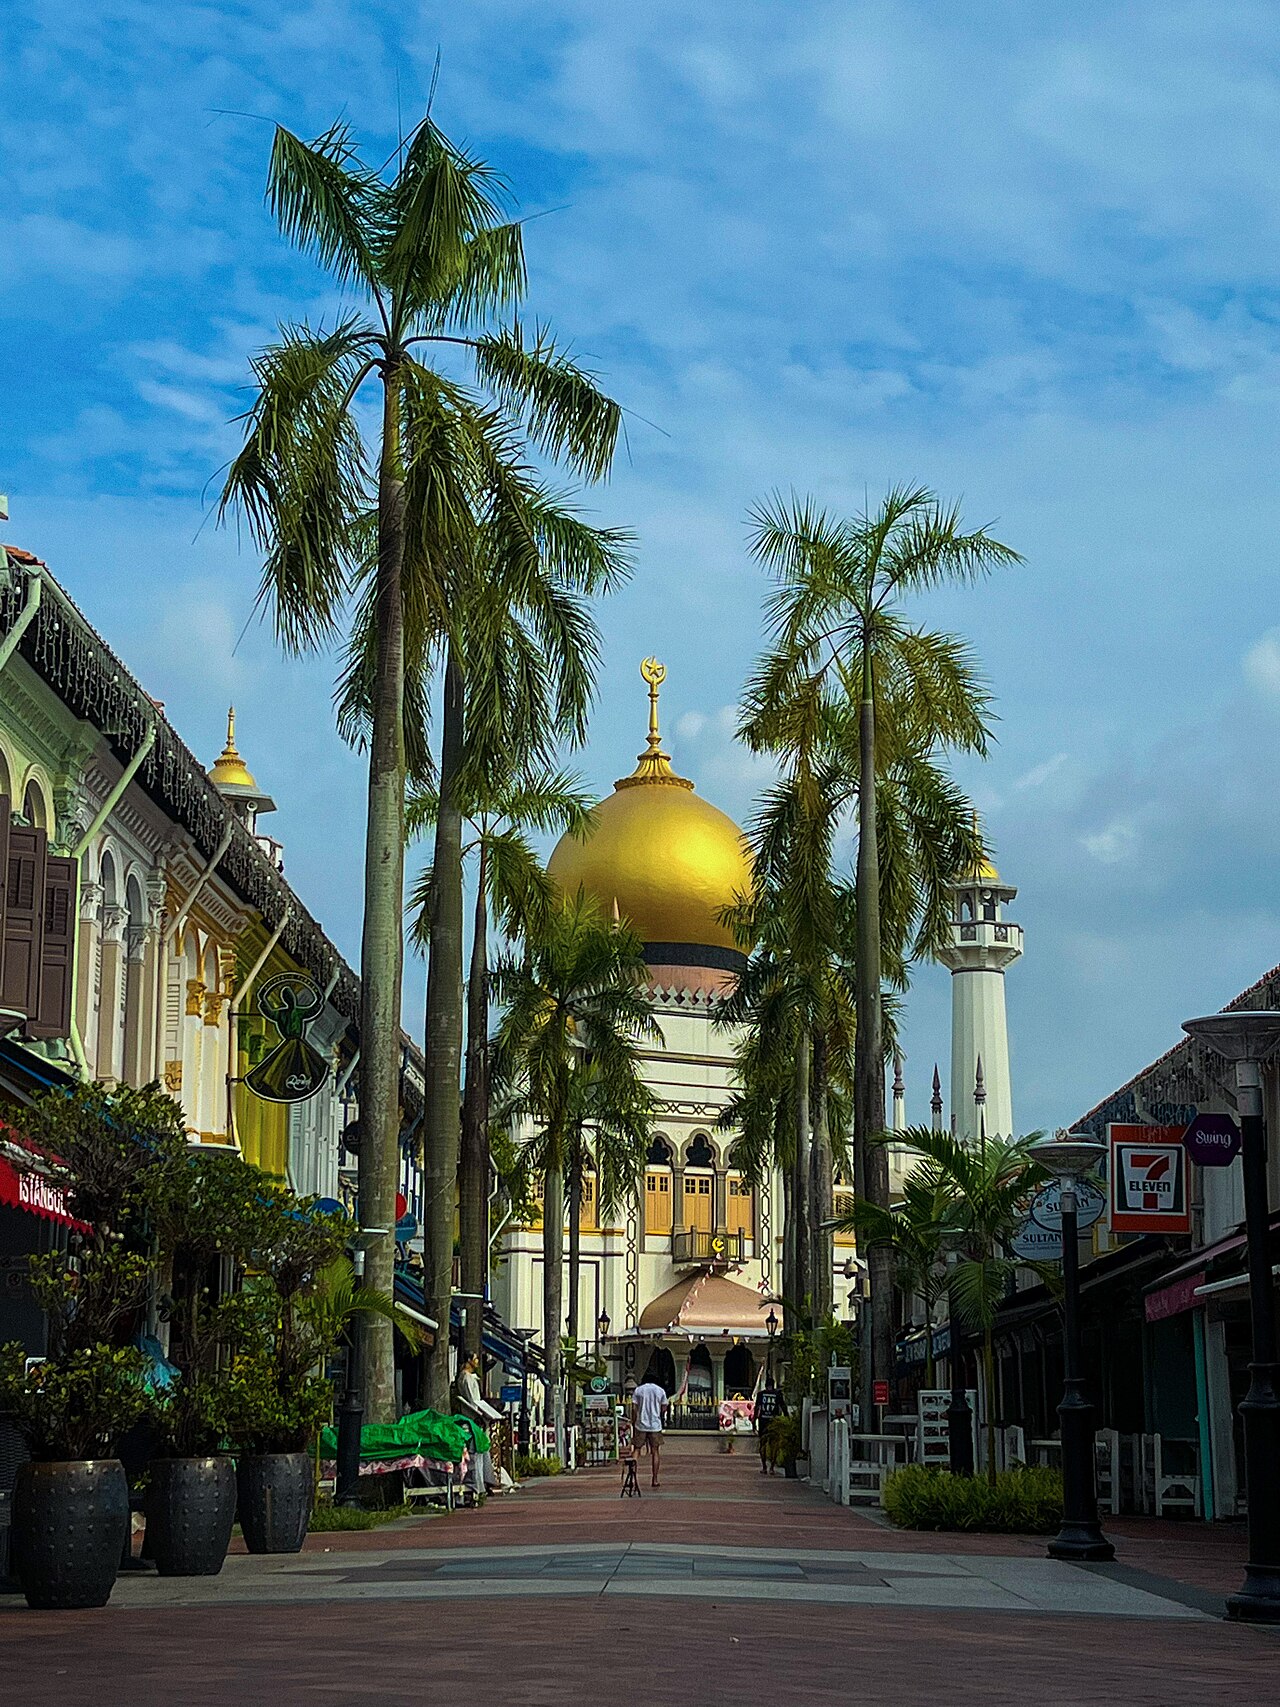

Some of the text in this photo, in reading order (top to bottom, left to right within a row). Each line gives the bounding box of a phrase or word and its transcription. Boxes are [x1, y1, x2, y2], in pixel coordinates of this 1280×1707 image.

[1195, 1129, 1232, 1149] Swing
[1130, 1153, 1170, 1210] 7
[1046, 1197, 1089, 1212] SUAN
